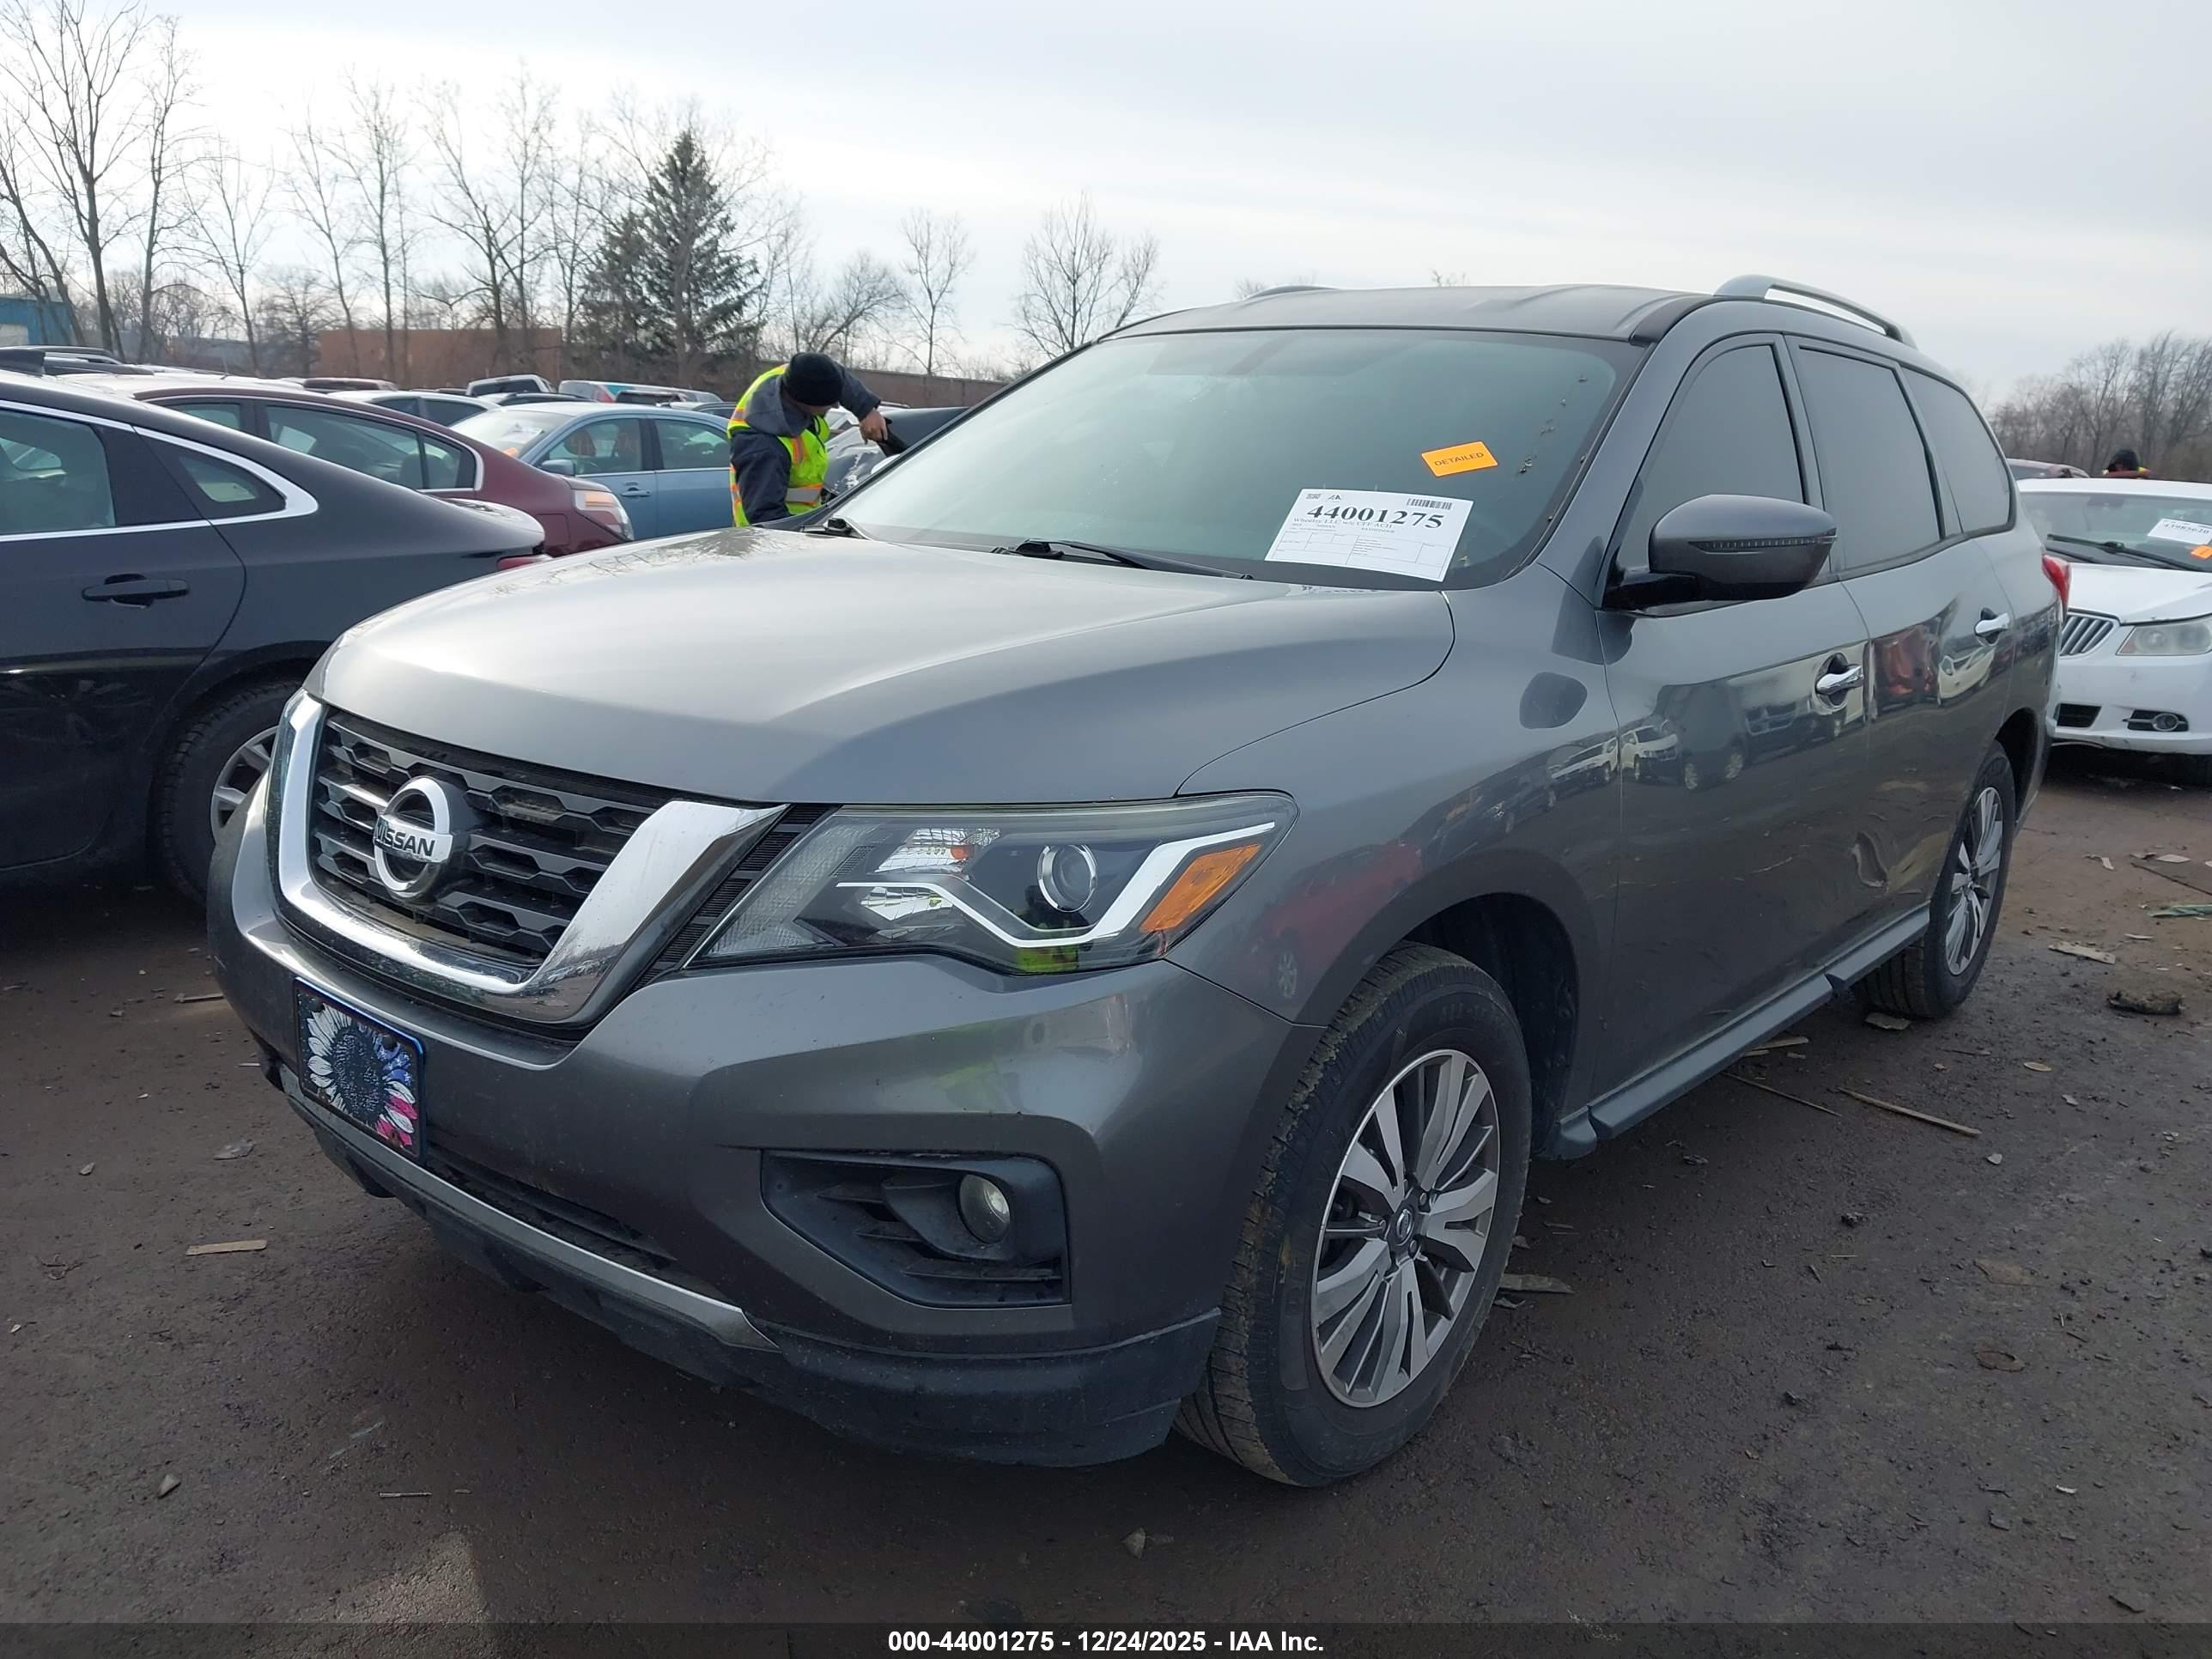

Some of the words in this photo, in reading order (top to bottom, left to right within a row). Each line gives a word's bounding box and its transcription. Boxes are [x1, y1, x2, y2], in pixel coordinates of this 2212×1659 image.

[1434, 452, 1484, 465] DETAILED
[1306, 505, 1444, 528] 44001275
[375, 821, 435, 857] NISSAN
